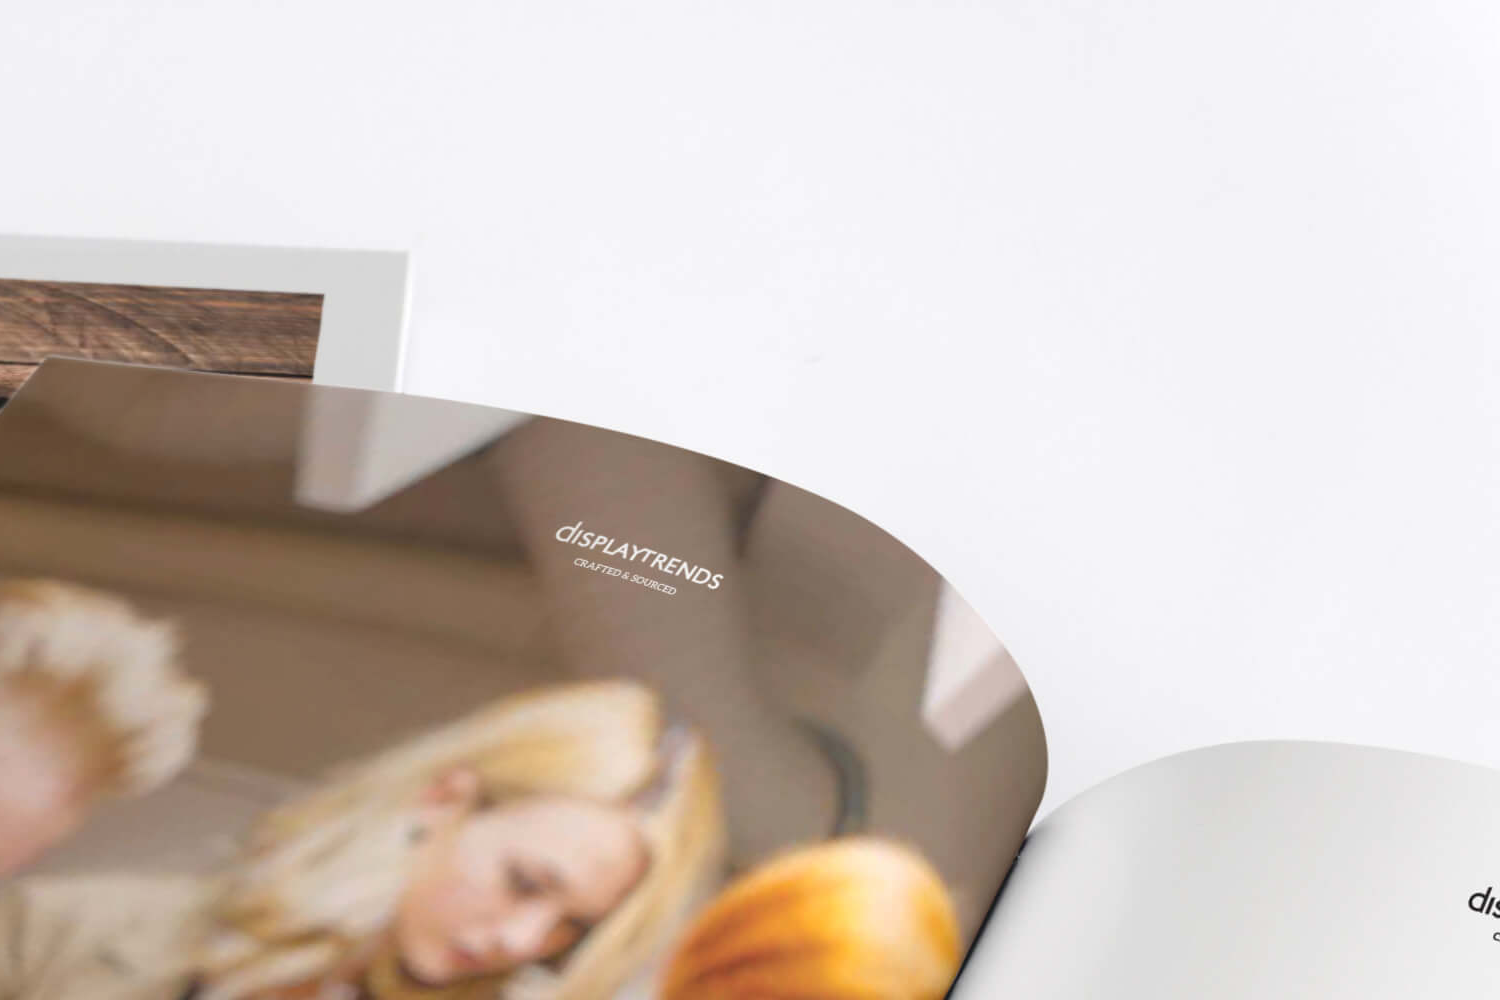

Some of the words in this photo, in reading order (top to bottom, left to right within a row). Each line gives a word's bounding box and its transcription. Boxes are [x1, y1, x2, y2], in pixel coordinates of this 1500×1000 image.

[573, 557, 622, 577] CRAFTED
[621, 571, 629, 580] &
[630, 573, 677, 596] SOURCED
